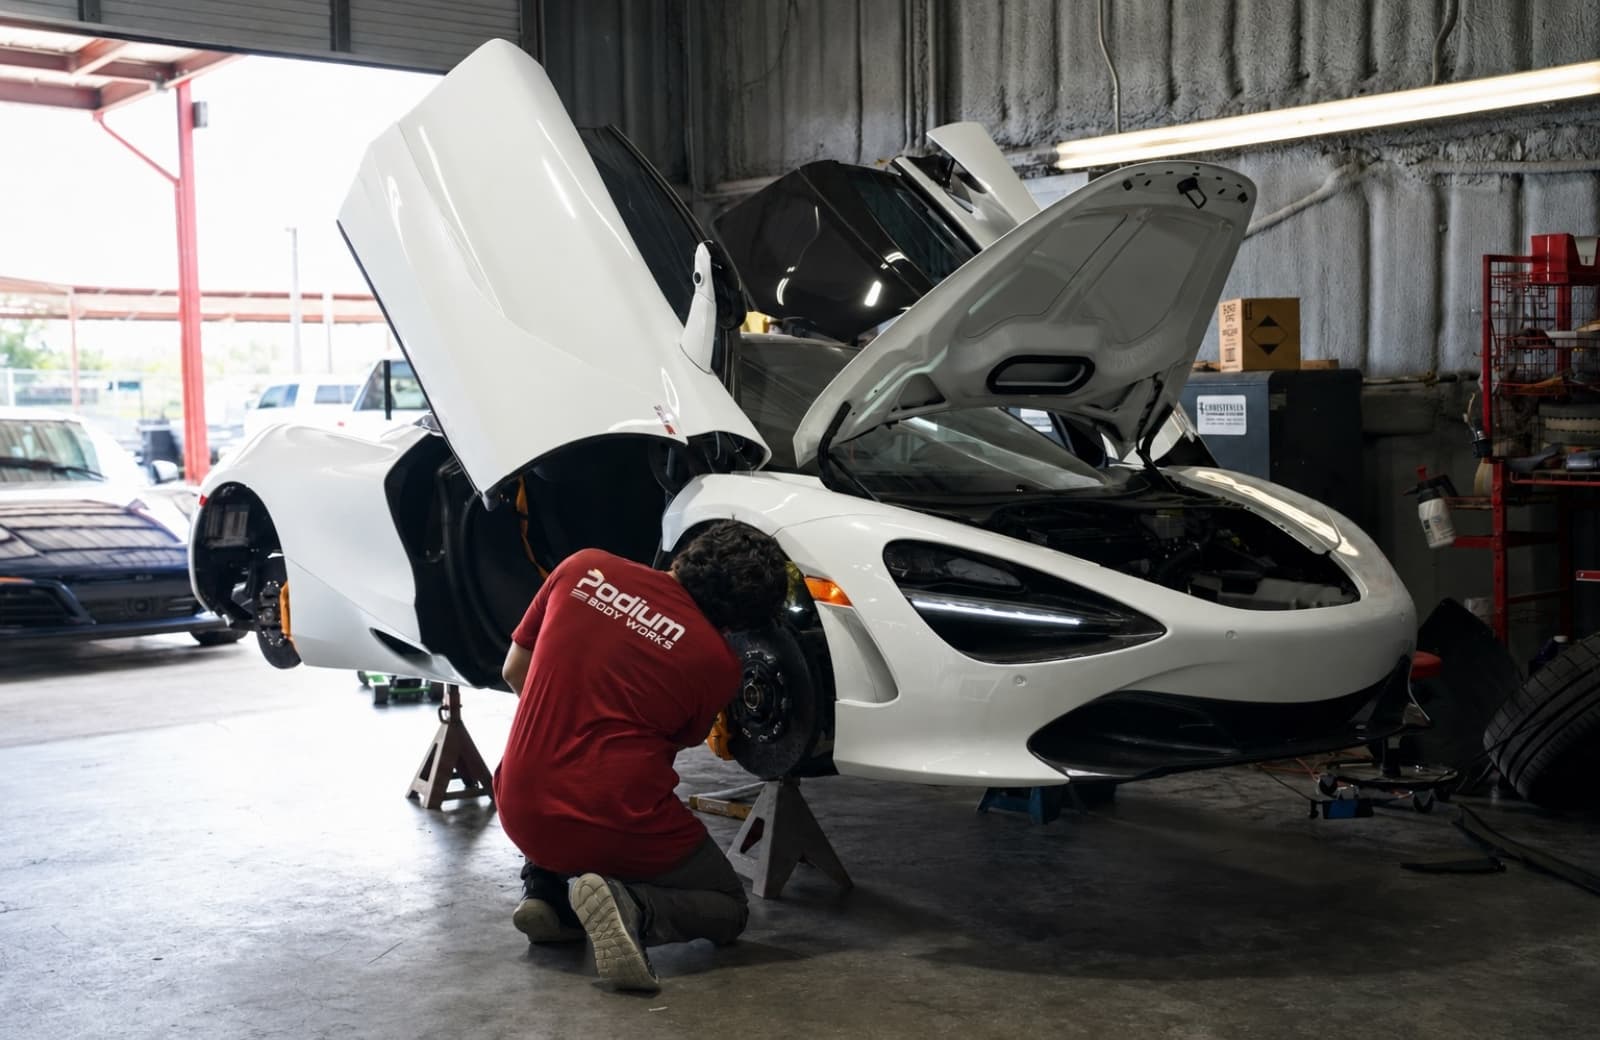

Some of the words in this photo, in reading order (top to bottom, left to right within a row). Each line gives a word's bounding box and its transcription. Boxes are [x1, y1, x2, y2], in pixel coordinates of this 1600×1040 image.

[576, 568, 686, 642] Podium
[587, 597, 623, 620] BODY
[625, 618, 675, 650] WORKS
